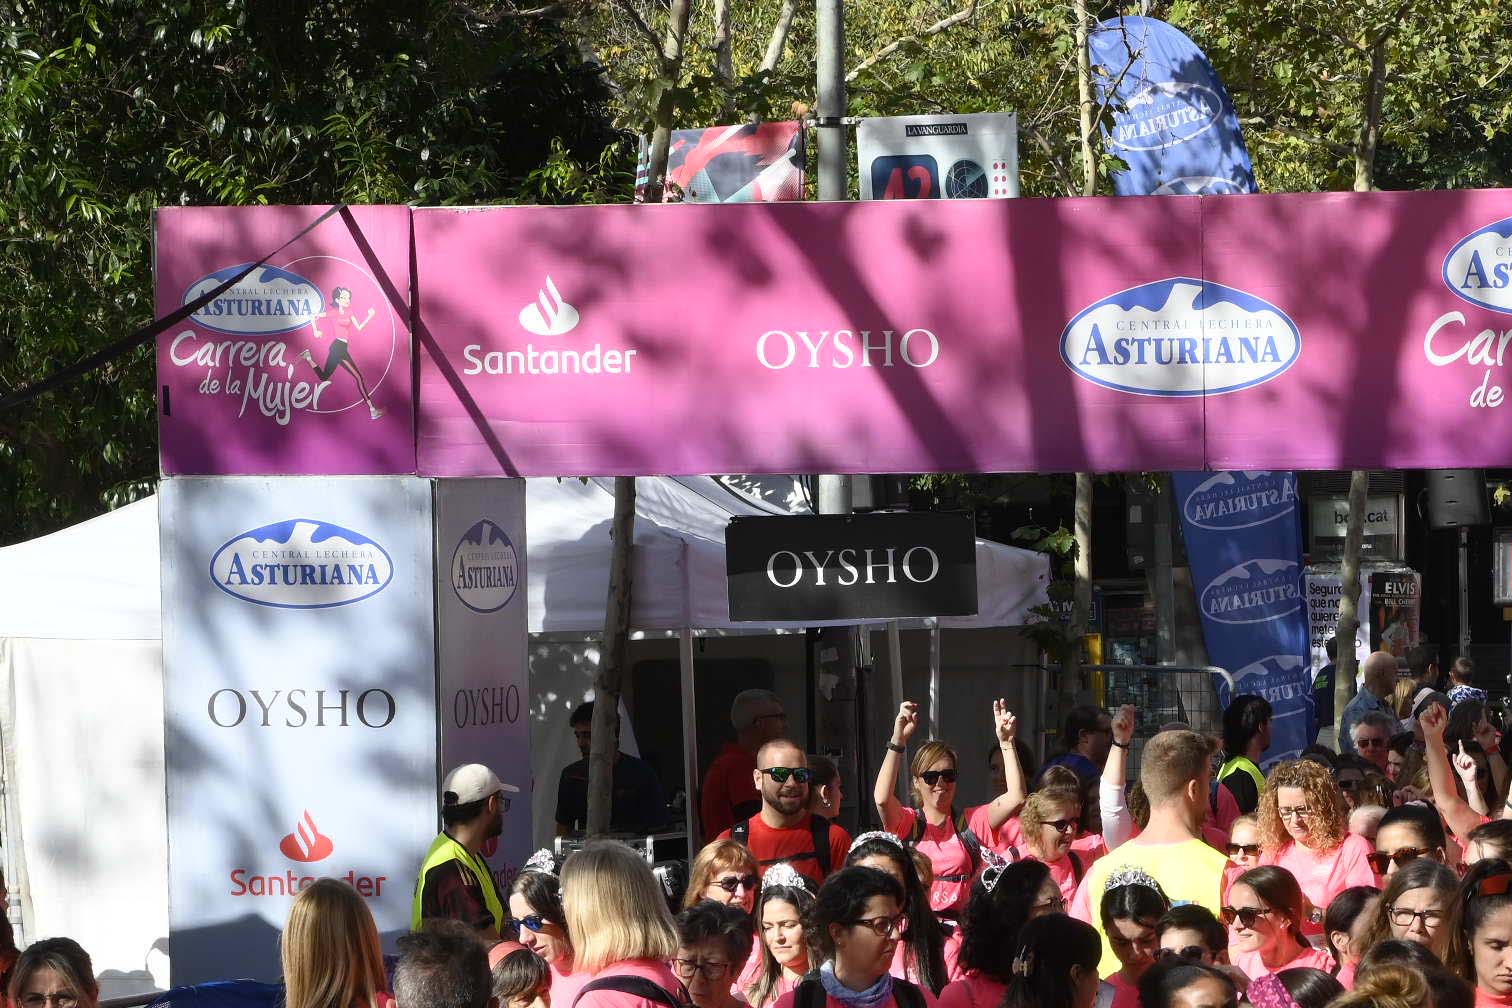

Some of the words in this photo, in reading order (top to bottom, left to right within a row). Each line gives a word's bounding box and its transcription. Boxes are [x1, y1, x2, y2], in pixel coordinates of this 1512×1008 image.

[918, 123, 968, 135] VANGUARDIA
[195, 290, 313, 317] ASTURIANA
[1116, 319, 1187, 331] CENTRAL
[170, 330, 287, 367] Carrera
[463, 344, 637, 375] Santander
[756, 329, 939, 370] OYSHO
[1079, 322, 1282, 366] ASTURIANA
[198, 369, 220, 394] de
[226, 368, 241, 394] la
[239, 364, 332, 425] Mujer
[1470, 370, 1504, 408] de
[225, 553, 380, 586] ASTURIANA
[252, 550, 313, 559] CENTRAL
[316, 550, 374, 559] LECHERA
[766, 546, 940, 588] OYSHO
[456, 556, 515, 590] ASTURIANA
[1385, 582, 1416, 594] ELVIS
[1311, 611, 1343, 622] quiere
[1311, 624, 1337, 635] mete
[207, 688, 397, 728] OYSHO
[454, 684, 520, 729] OYSHO
